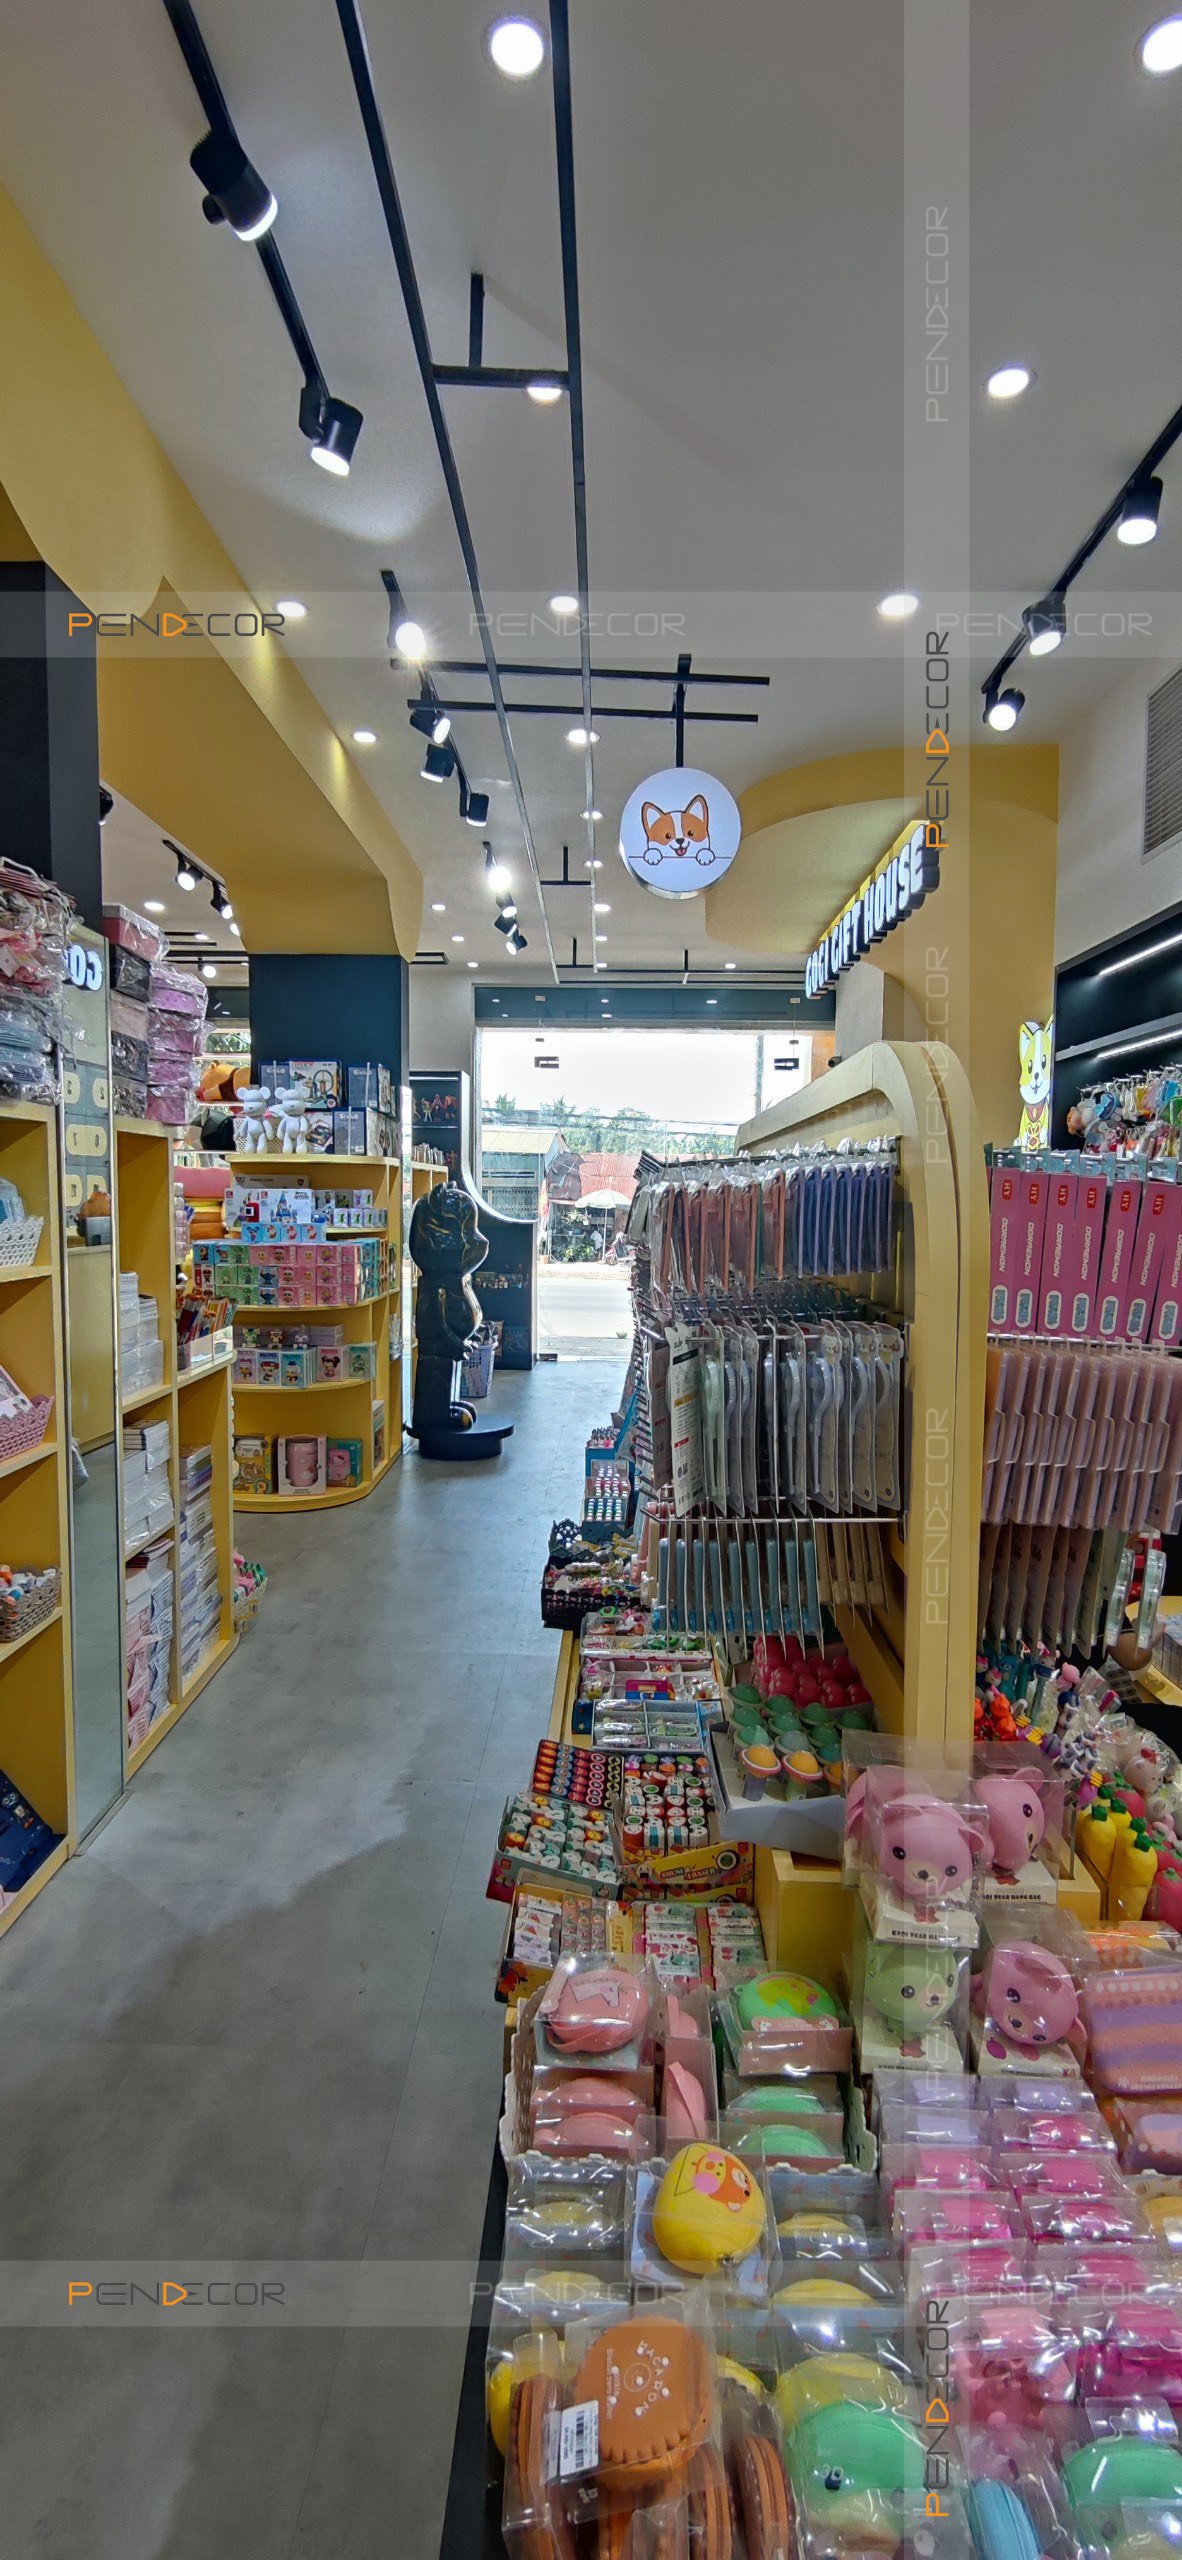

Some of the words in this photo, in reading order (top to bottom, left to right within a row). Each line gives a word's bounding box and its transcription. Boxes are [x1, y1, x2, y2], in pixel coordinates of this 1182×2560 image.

[830, 900, 864, 974] GIFT
[864, 823, 925, 945] HOUSE
[1004, 1182, 1011, 1197] HY
[1030, 1186, 1038, 1202] HY
[1059, 1188, 1066, 1203] HY
[1088, 1191, 1096, 1206] HY
[1121, 1194, 1129, 1209] HY
[1154, 1197, 1162, 1213] HY
